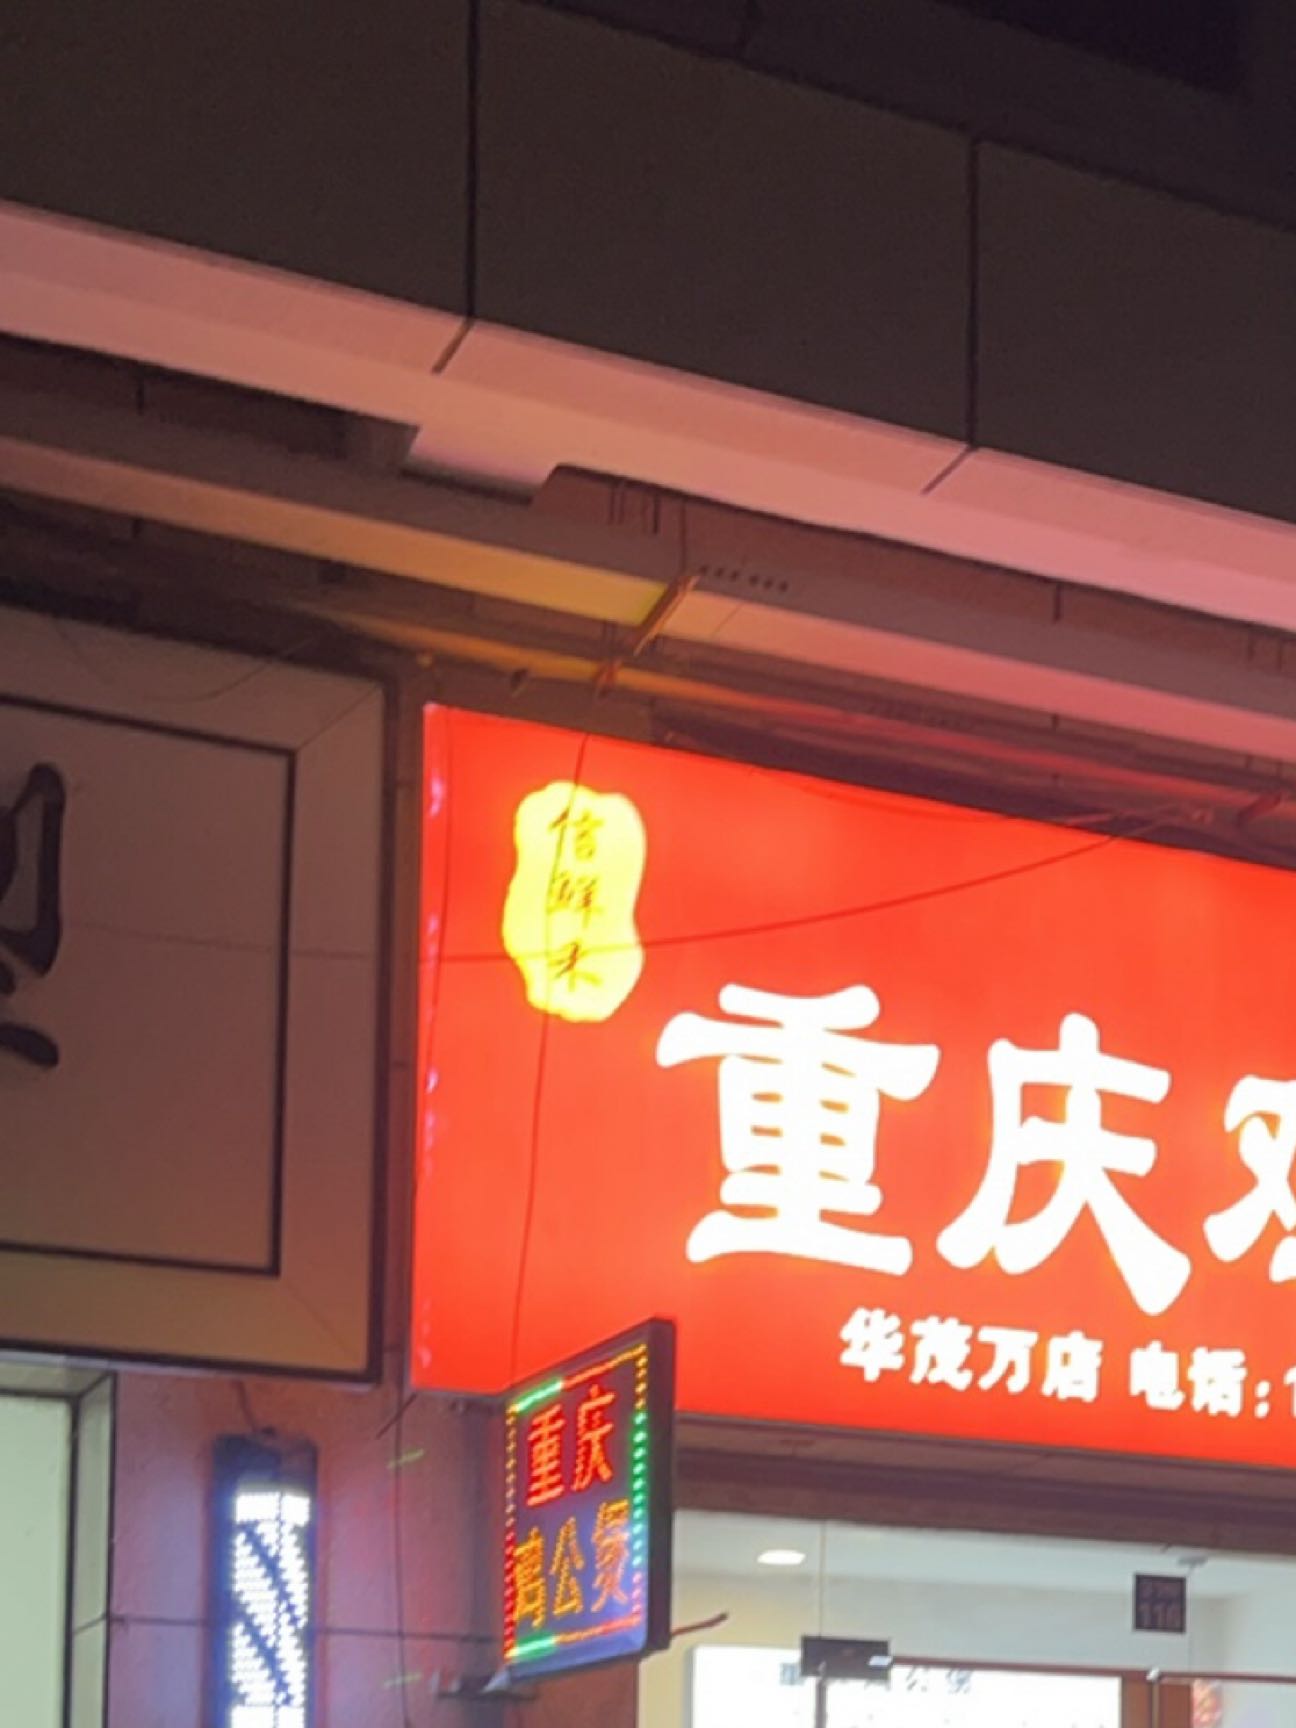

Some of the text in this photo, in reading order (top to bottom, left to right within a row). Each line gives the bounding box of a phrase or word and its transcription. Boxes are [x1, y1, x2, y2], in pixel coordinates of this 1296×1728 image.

[840, 1307, 1102, 1402] 华茂万店
[526, 1384, 616, 1507] 重庆
